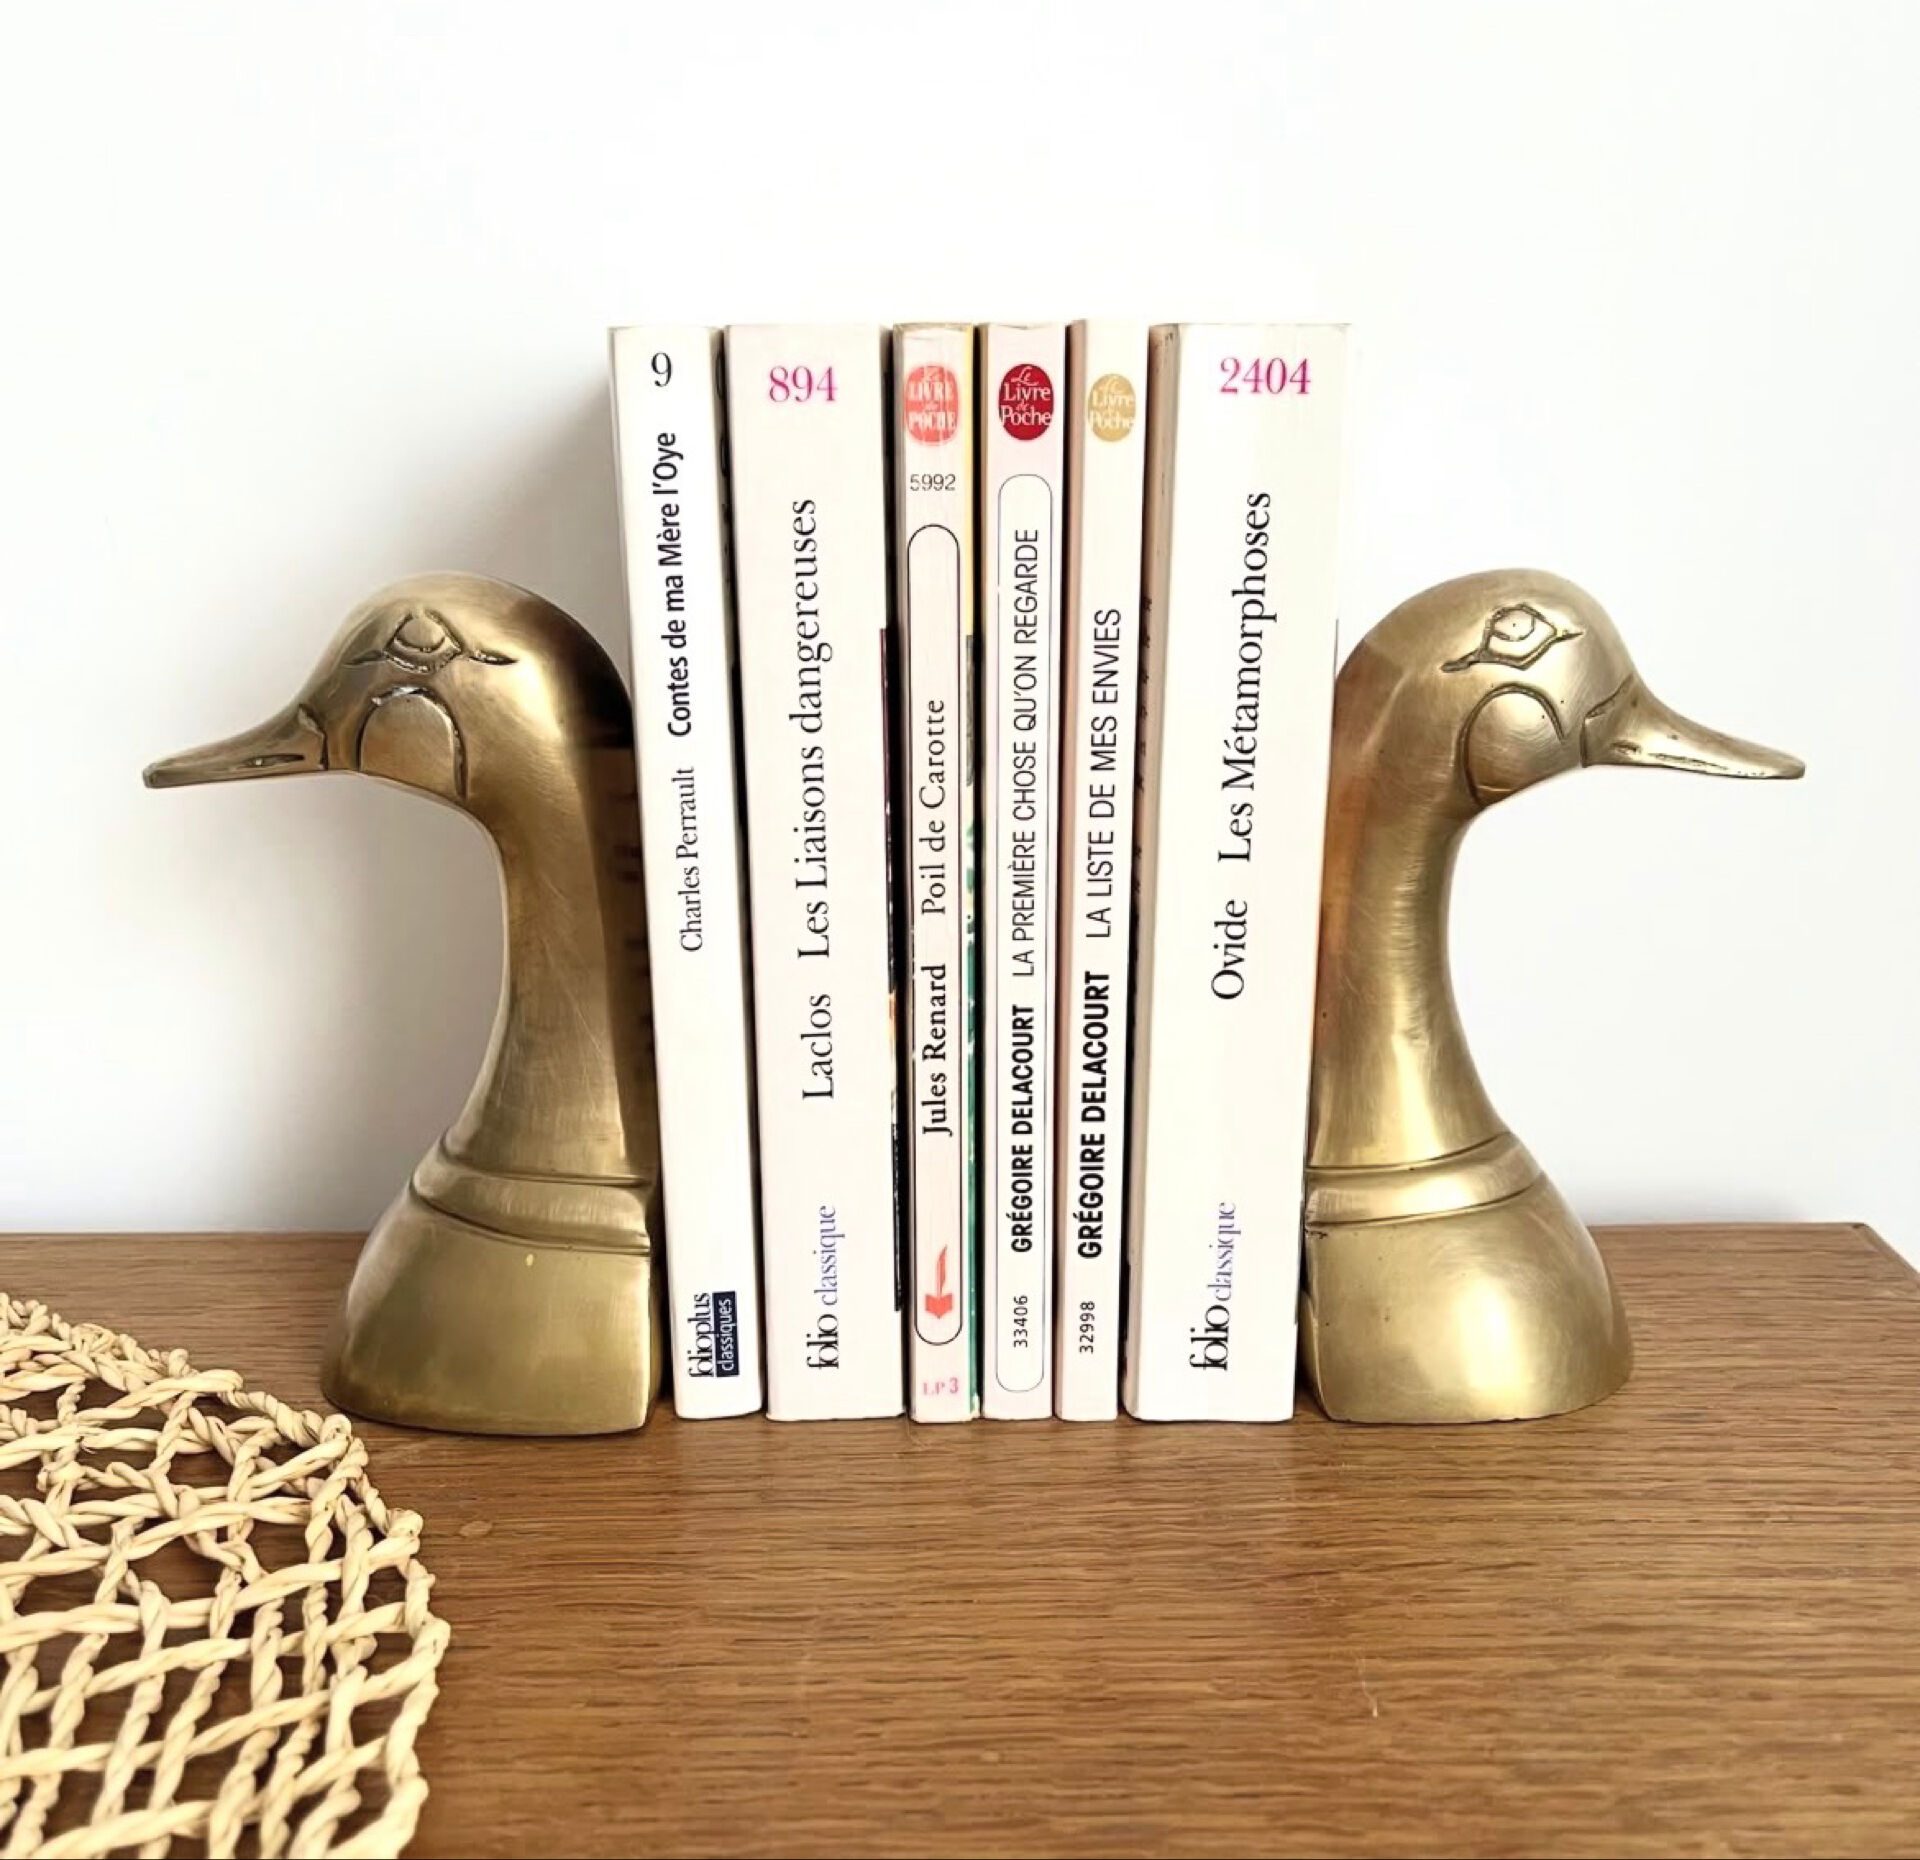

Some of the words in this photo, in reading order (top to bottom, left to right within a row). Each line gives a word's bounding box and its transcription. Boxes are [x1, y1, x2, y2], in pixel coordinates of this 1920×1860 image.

[651, 353, 672, 387] 9
[768, 366, 838, 402] 894
[1003, 383, 1051, 401] Livre
[1011, 366, 1039, 386] Le
[1092, 389, 1133, 407] Livre
[1220, 358, 1311, 394] 2404
[1000, 405, 1052, 426] Poche
[1089, 409, 1134, 431] Poche
[652, 432, 684, 495] l'Oye
[910, 474, 956, 491] 5992
[656, 504, 684, 567] Mère
[664, 575, 685, 613] ma
[789, 499, 833, 734] dangereuses
[1013, 529, 1039, 644] REGARDE
[661, 619, 687, 649] de
[1092, 608, 1122, 705] ENVIES
[1221, 492, 1277, 791] Métamorphoses
[667, 656, 692, 737] Contes
[1013, 656, 1038, 731] QU'ON
[919, 700, 946, 810] Carotte
[1090, 715, 1118, 772] MES
[671, 766, 699, 860] Perrault
[1012, 741, 1037, 821] CHOSE
[1089, 784, 1116, 818] DE
[793, 746, 828, 890] Liaisons
[919, 820, 946, 852] de
[1218, 803, 1254, 862] Les
[920, 863, 946, 915] Poil
[1008, 831, 1036, 941] PREMIÈRE
[1087, 831, 1114, 897] LISTE
[678, 866, 703, 952] Charles
[797, 901, 830, 958] Les
[1086, 907, 1112, 938] LA
[1012, 949, 1035, 977] LA
[1211, 899, 1248, 1001] Ovide
[800, 994, 834, 1100] Laclos
[920, 963, 946, 1068] Renard
[1080, 970, 1110, 1123] DELACOURT
[1011, 1005, 1035, 1135] DELACOURT
[921, 1071, 953, 1137] Jules
[1006, 1145, 1034, 1253] GRÉGOIRE
[1073, 1133, 1106, 1260] GRÉGOIRE
[814, 1205, 846, 1306] classique
[1207, 1202, 1242, 1301] classique
[687, 1292, 714, 1379] folioplus
[715, 1297, 736, 1371] classiques
[806, 1313, 840, 1370] folio
[1013, 1295, 1029, 1348] 33406
[1079, 1300, 1096, 1354] 32998
[1189, 1304, 1231, 1371] folio
